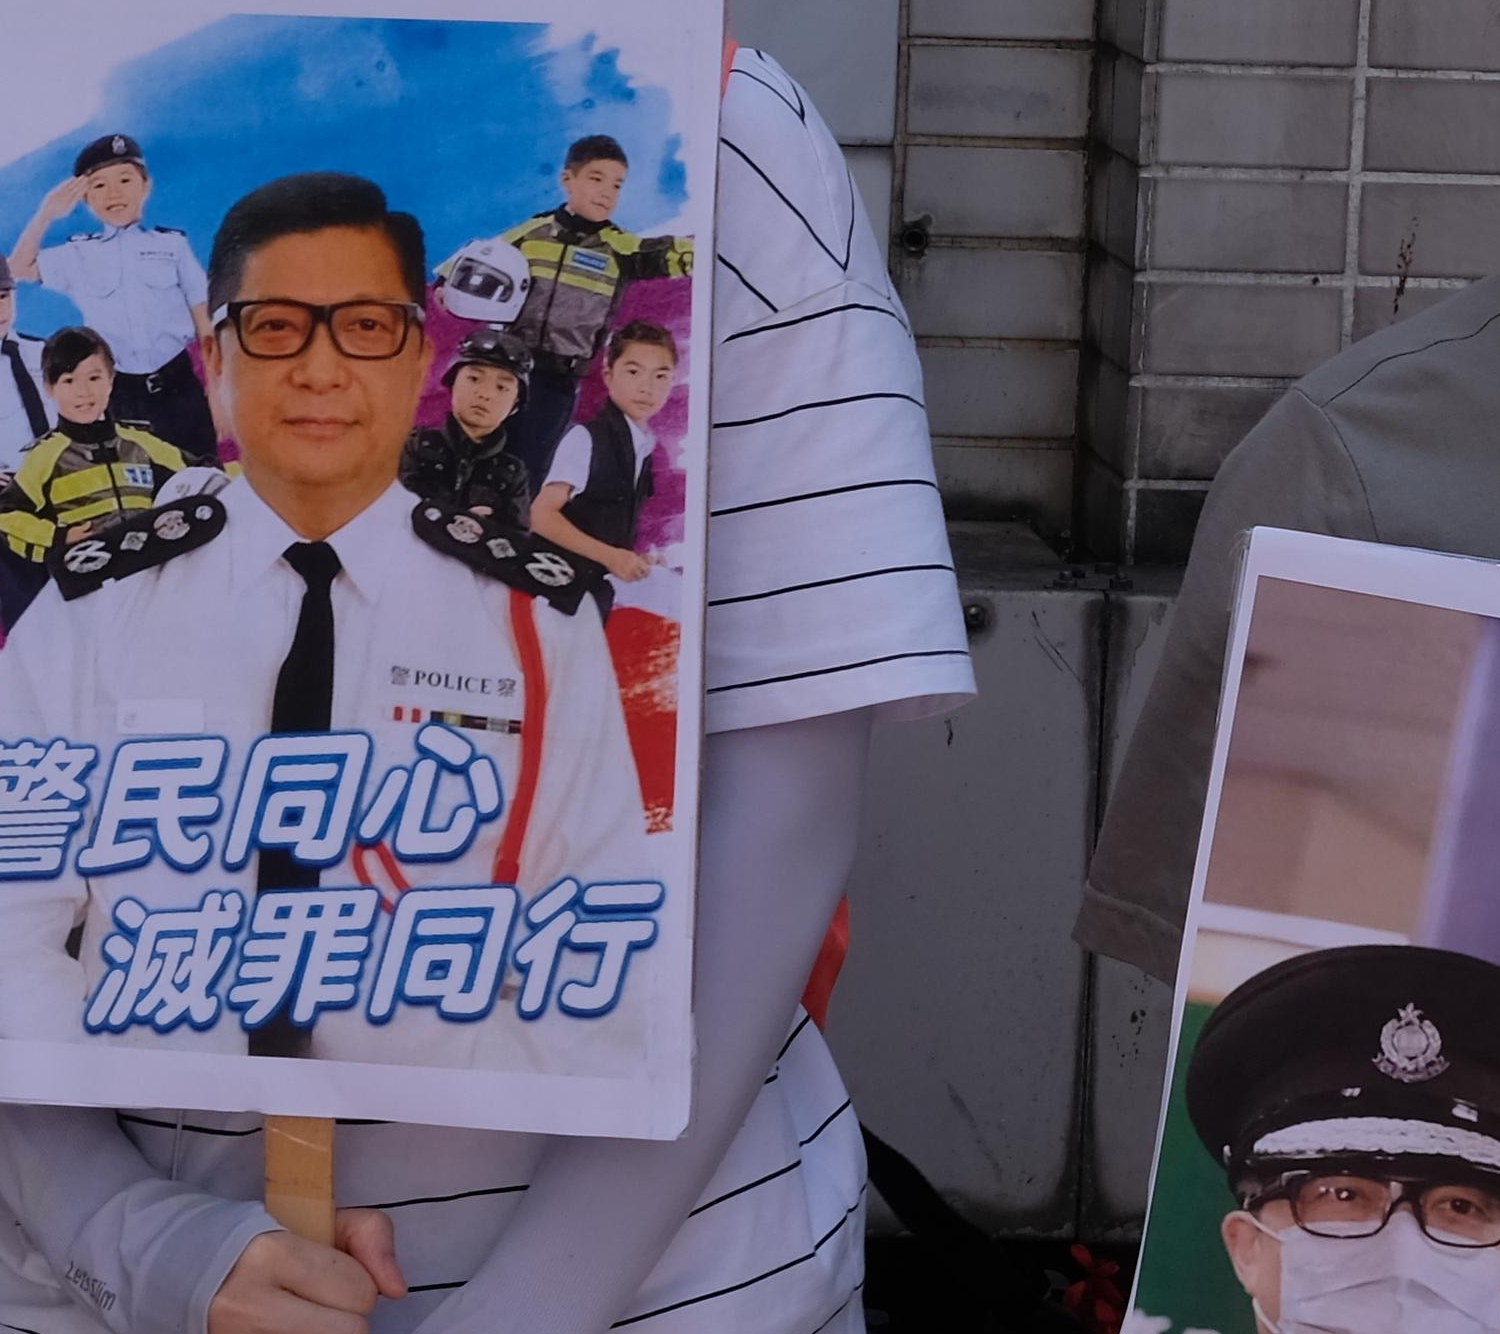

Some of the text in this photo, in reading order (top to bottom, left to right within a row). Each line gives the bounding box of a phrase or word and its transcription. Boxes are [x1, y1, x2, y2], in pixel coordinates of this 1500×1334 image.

[413, 670, 491, 695] POLICE
[84, 877, 664, 1033] 滅罪同行
